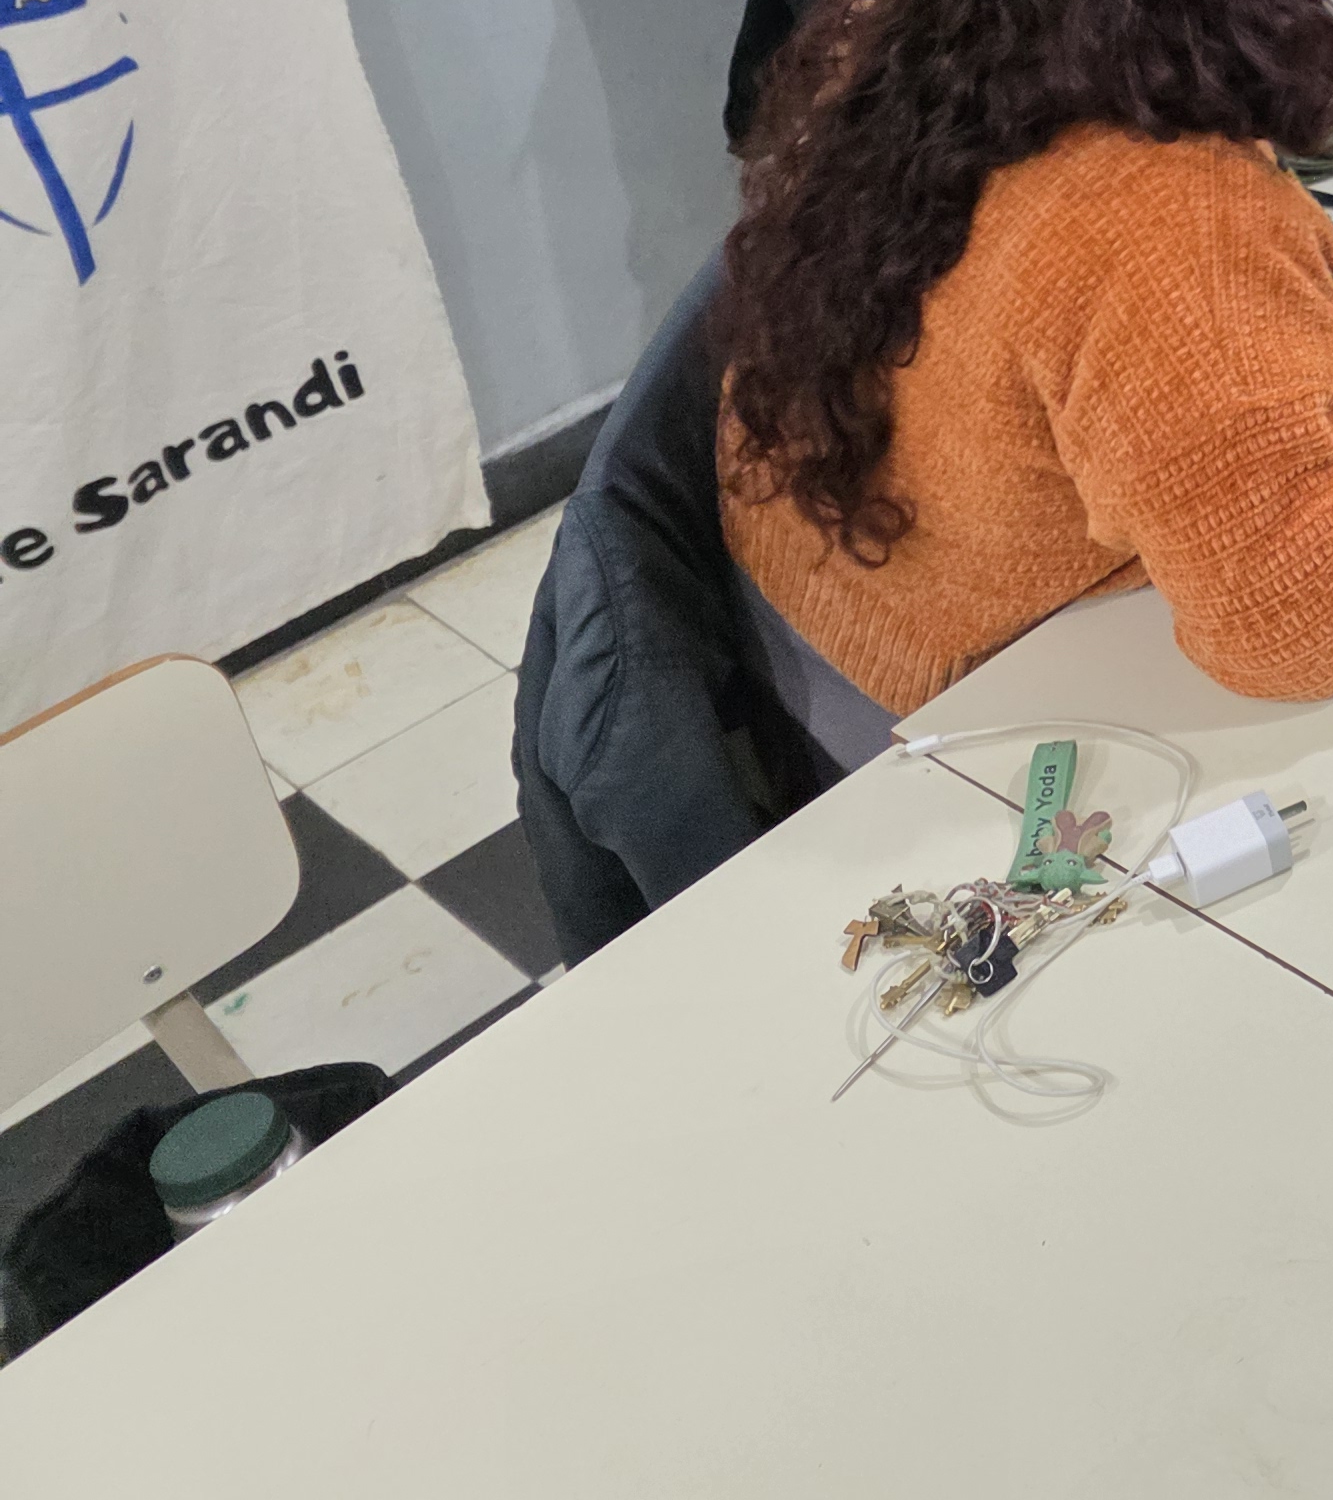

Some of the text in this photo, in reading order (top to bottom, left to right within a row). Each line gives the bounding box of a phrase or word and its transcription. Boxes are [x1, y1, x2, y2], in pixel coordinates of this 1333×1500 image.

[0, 350, 365, 570] e Sarandi
[1034, 764, 1057, 812] Yoda
